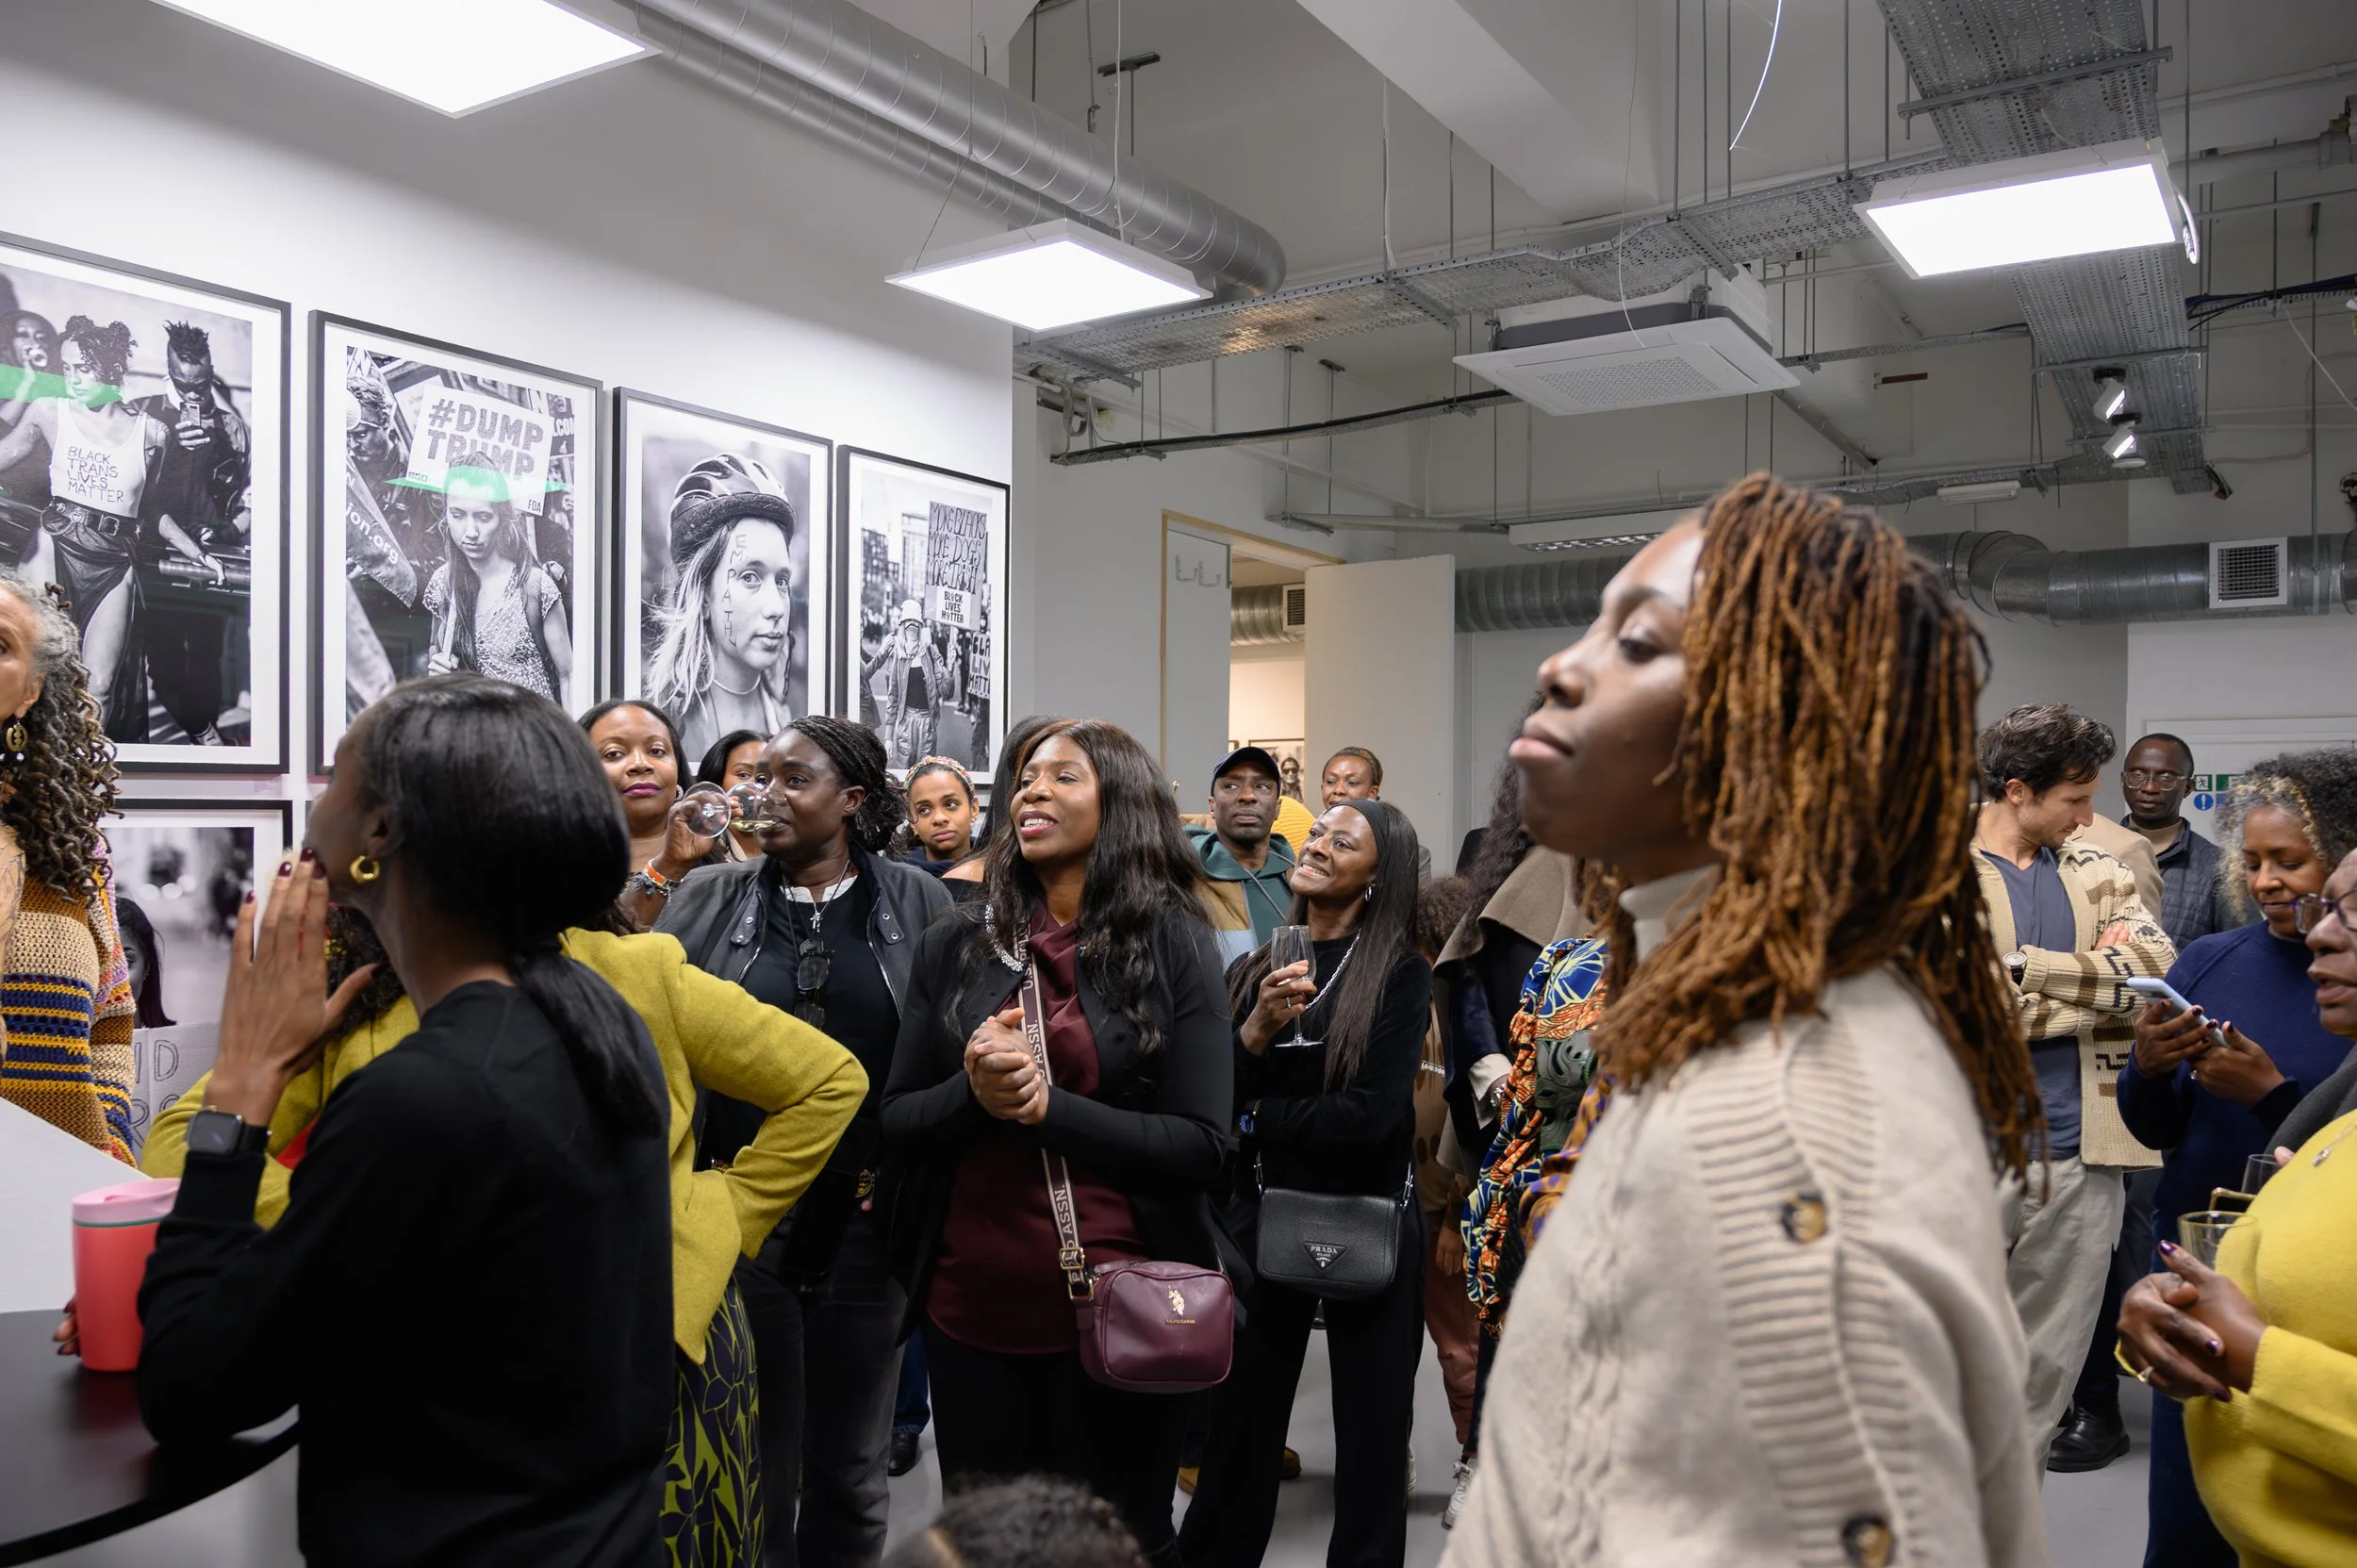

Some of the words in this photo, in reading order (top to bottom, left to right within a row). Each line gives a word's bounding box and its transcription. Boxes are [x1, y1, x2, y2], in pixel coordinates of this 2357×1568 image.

[428, 399, 544, 451] #DUMP
[67, 457, 119, 478] TRANS
[68, 446, 111, 464] BLACK
[67, 470, 108, 489] LIVES
[68, 481, 124, 503] MATTER
[346, 503, 398, 565] ion.org
[927, 530, 949, 558] MORE
[952, 535, 981, 568] DOGS
[926, 556, 948, 586] MORE
[945, 601, 962, 613] LIVES
[1027, 1019, 1044, 1065] ASSN.
[1054, 1184, 1074, 1235] ASSN.
[1310, 1246, 1338, 1254] PRADA
